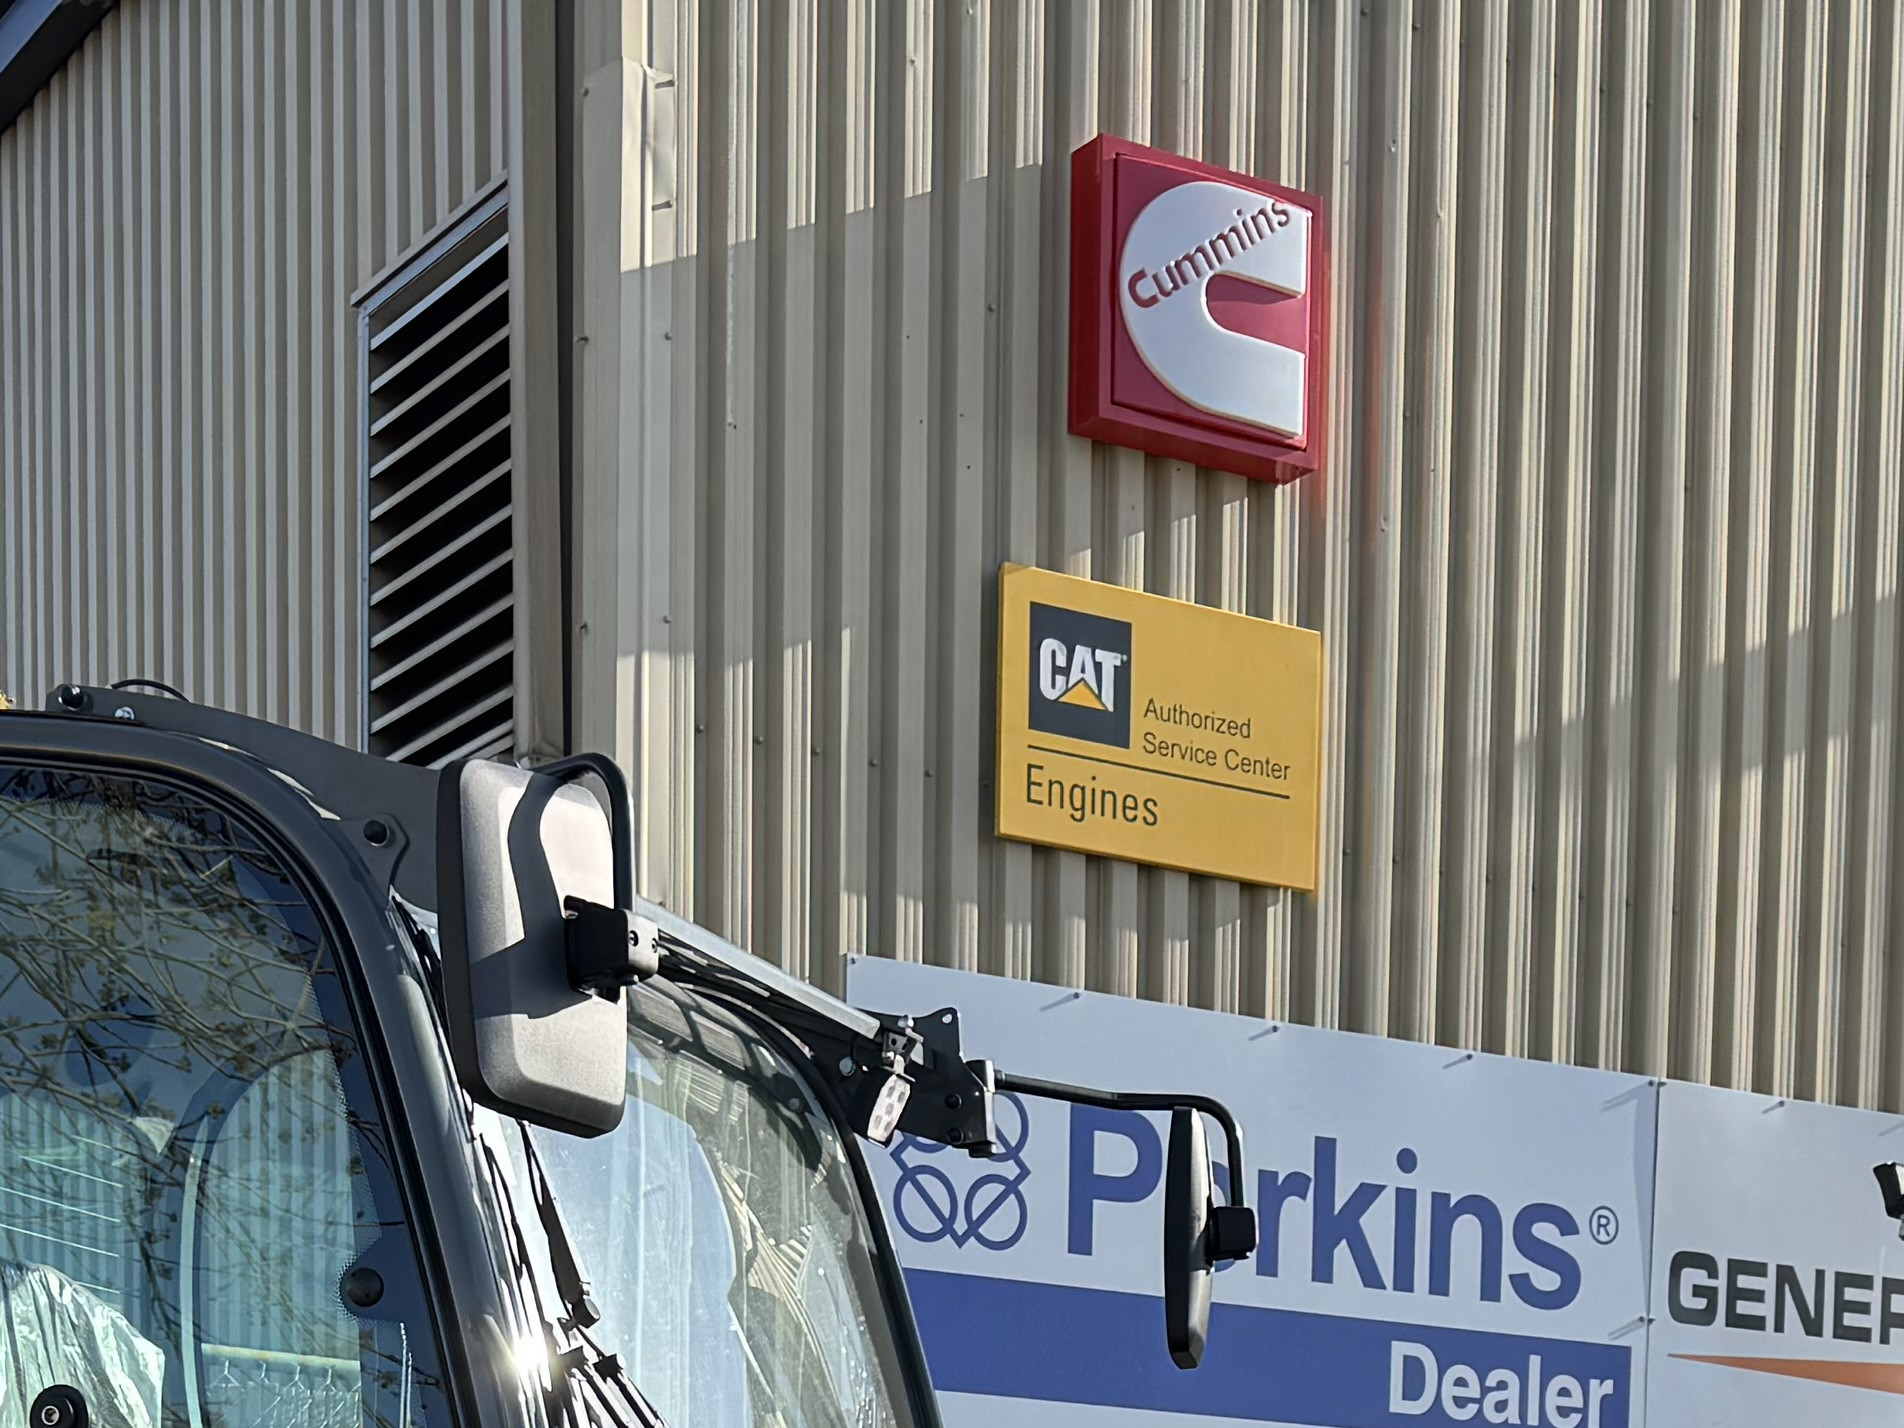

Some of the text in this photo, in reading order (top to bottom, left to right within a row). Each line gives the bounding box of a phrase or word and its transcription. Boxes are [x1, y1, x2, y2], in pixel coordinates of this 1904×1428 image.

[1128, 198, 1292, 309] Cummins
[1039, 636, 1123, 712] CAT
[1143, 697, 1253, 741] Authorized
[1142, 731, 1291, 783] Service Center
[1026, 764, 1160, 828] Engines
